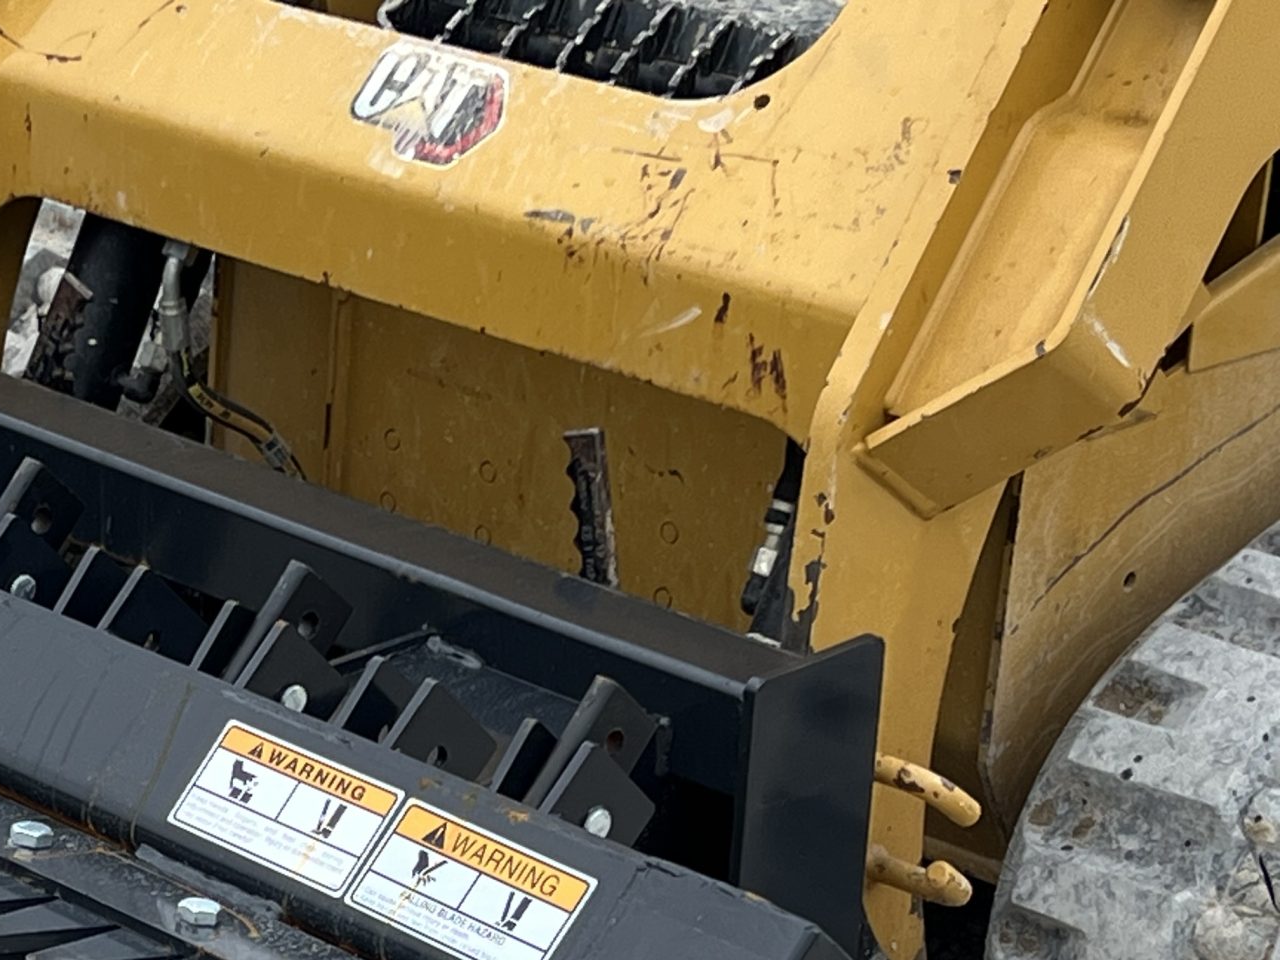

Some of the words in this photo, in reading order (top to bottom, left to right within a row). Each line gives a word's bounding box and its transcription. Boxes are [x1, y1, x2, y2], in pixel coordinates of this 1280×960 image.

[268, 750, 366, 802] WARNING
[451, 832, 561, 897] WARNING
[397, 889, 438, 914] FALLING
[436, 907, 468, 928] BLADE
[466, 921, 507, 946] HAZARD
